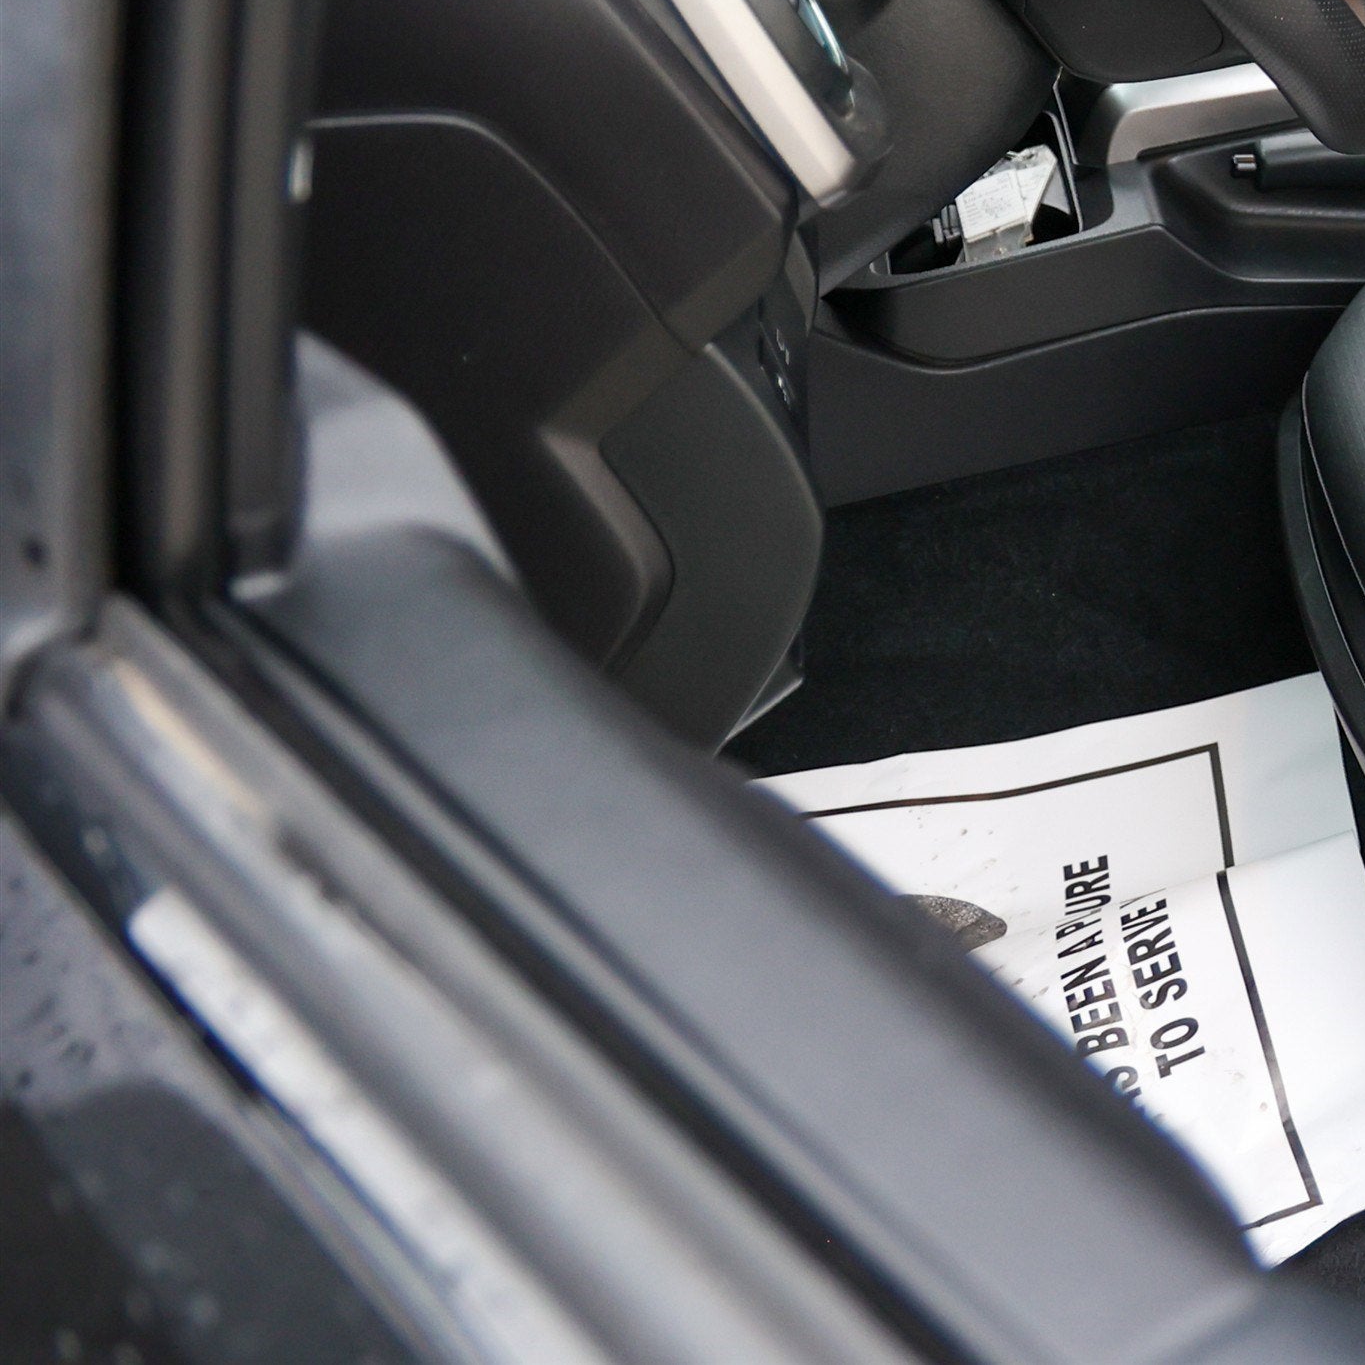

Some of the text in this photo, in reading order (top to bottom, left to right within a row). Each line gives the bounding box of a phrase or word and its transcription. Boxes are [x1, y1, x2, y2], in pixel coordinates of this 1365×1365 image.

[1057, 929, 1103, 959] A
[1119, 898, 1188, 1010] SERVE
[1060, 954, 1129, 1059] BEEN
[1150, 1017, 1205, 1078] TO
